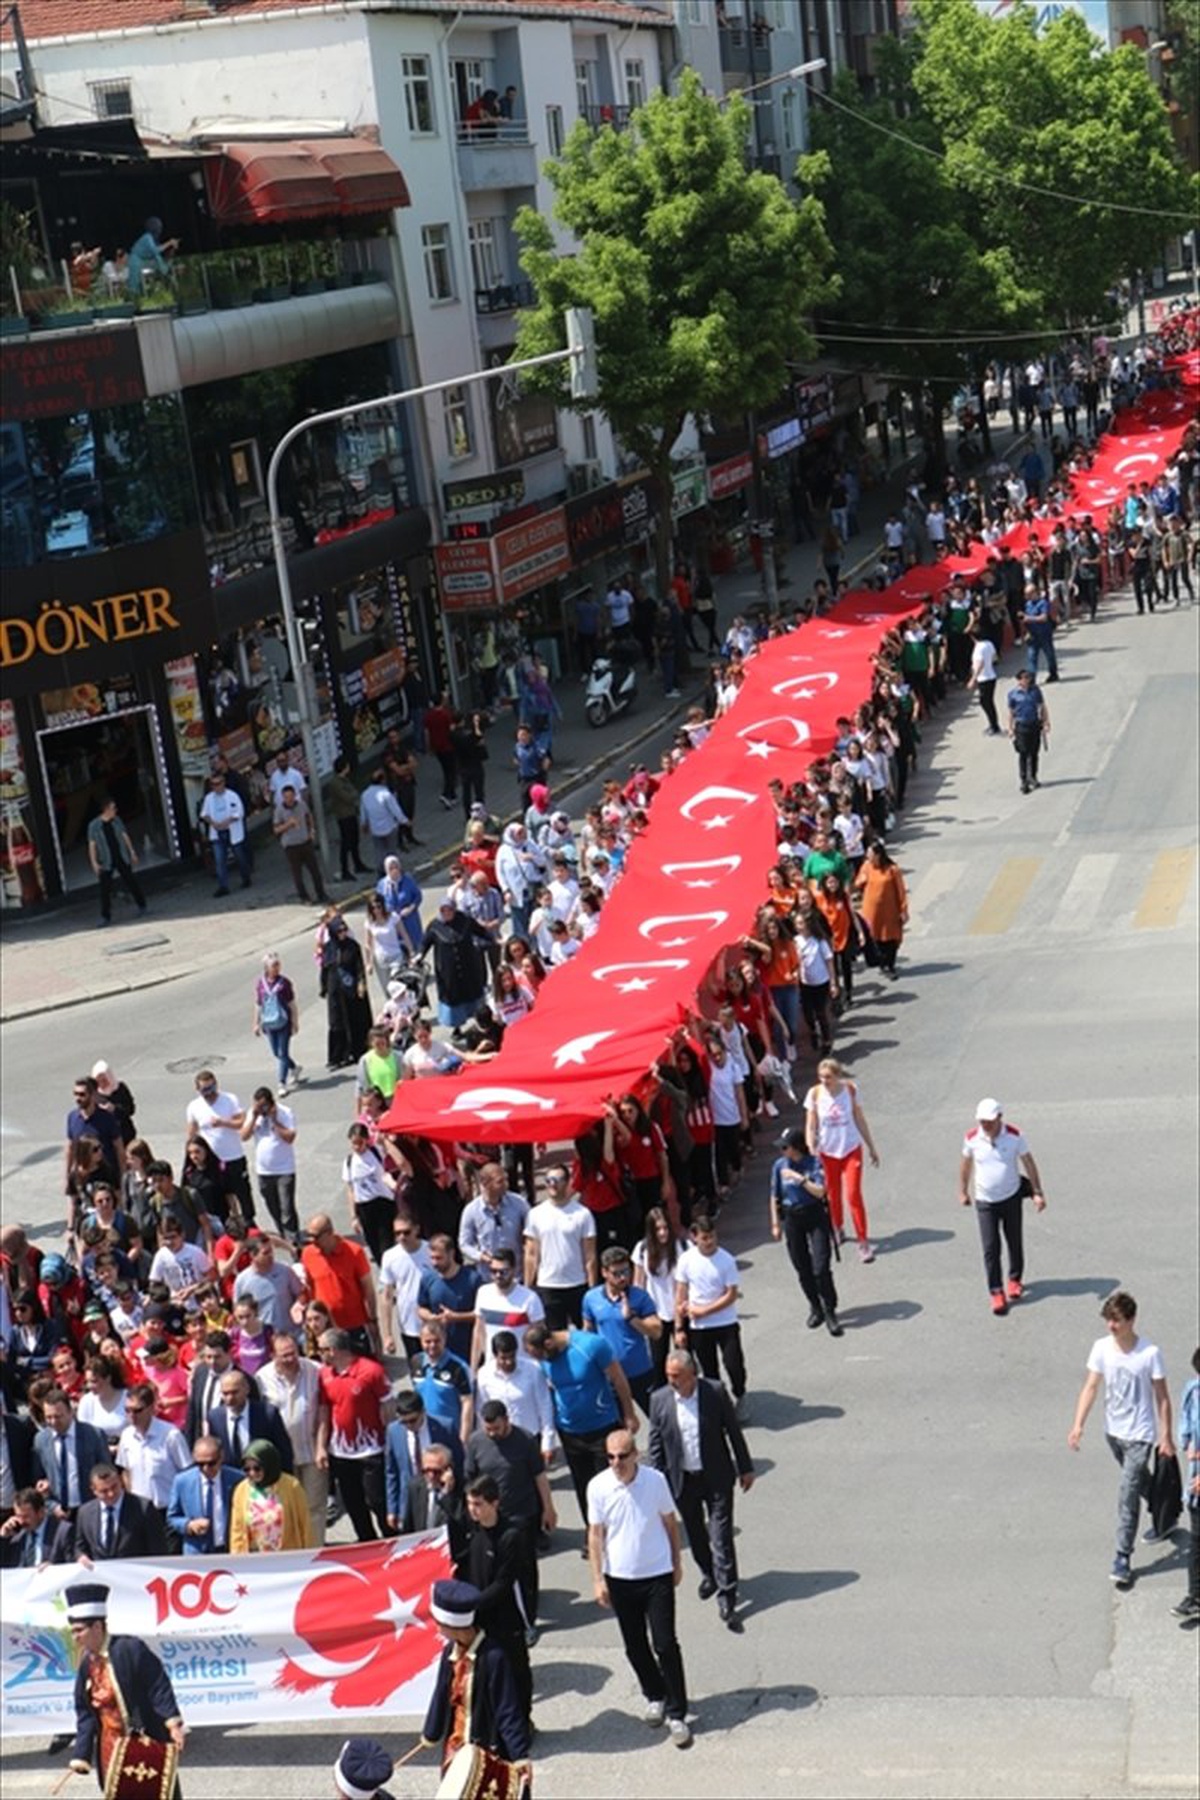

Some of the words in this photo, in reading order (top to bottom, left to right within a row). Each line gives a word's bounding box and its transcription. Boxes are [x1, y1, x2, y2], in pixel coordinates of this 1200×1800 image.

[0, 586, 180, 667] DÖNER
[146, 1569, 240, 1625] 100
[160, 1633, 258, 1659] gençlik
